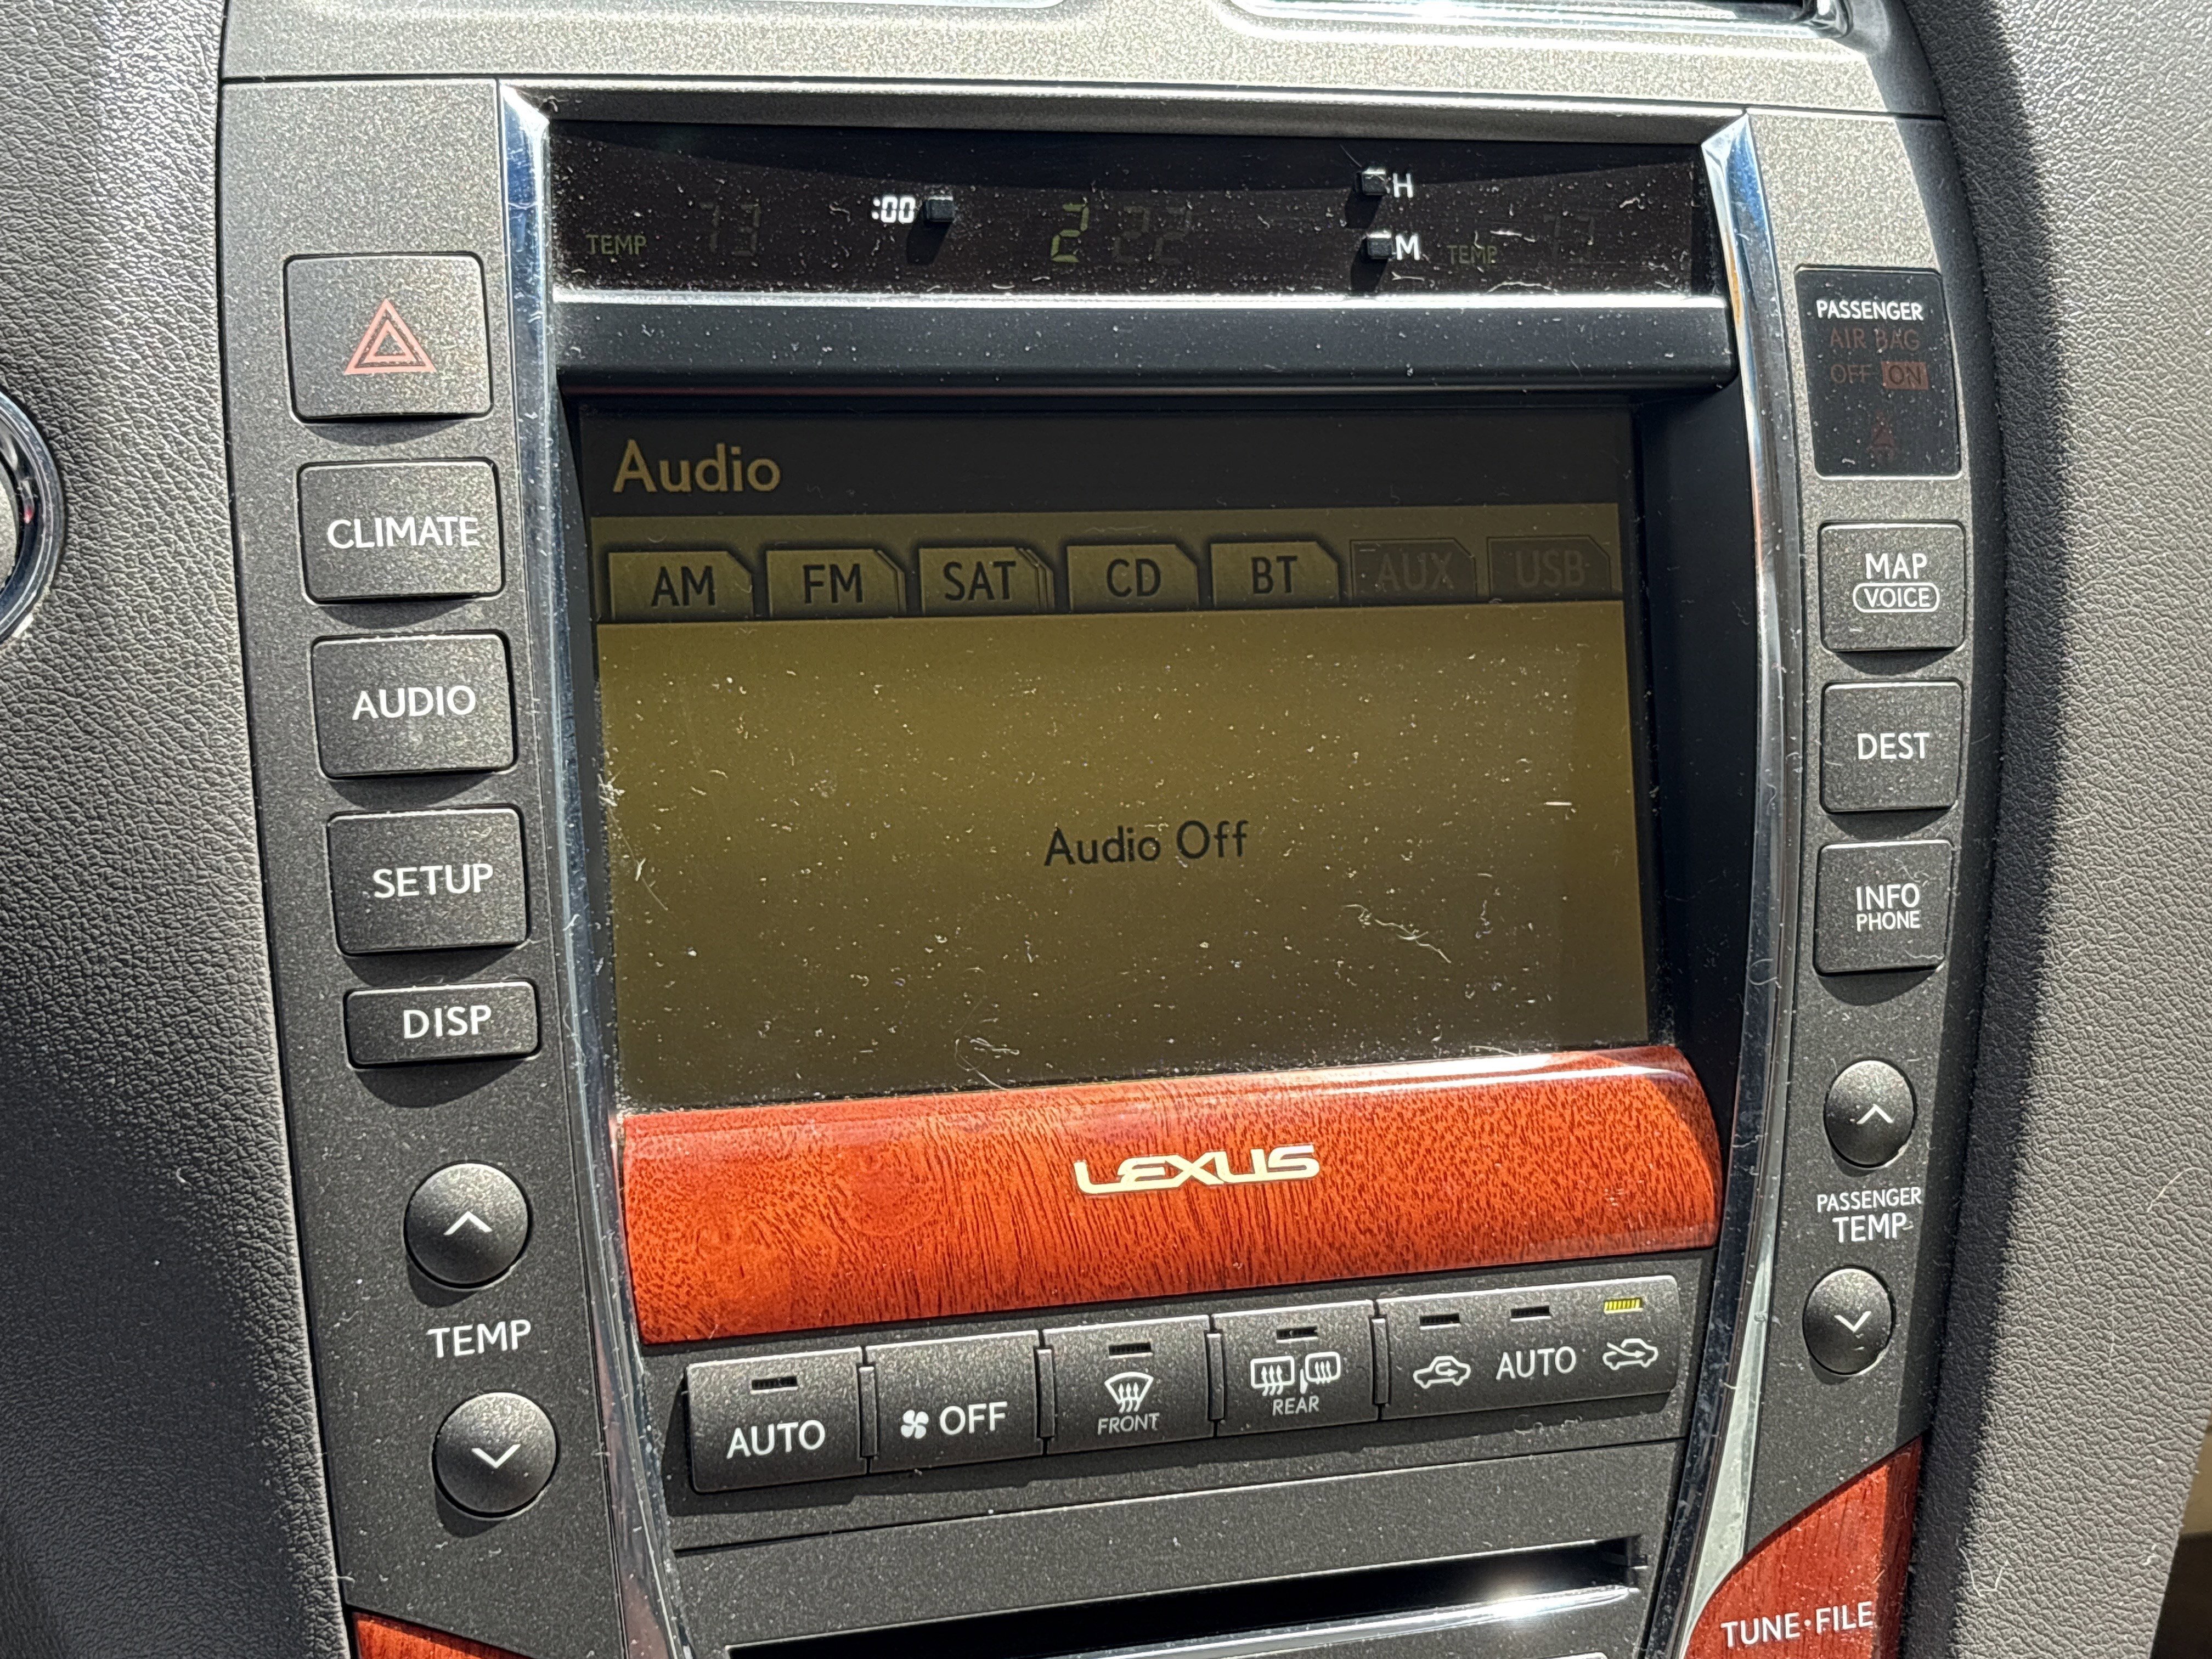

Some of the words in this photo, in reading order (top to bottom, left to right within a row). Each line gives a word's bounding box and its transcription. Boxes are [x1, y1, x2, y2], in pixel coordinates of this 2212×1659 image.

[1392, 173, 1414, 198] H
[873, 195, 916, 223] :00
[586, 234, 647, 256] TEMP
[1395, 234, 1421, 261] M
[1447, 245, 1498, 264] TEMP
[1815, 298, 1924, 321] PASSENGER
[1830, 327, 1866, 349] AIR
[1874, 328, 1920, 351] BAG
[1830, 363, 1872, 384] OFF
[1887, 364, 1922, 386] ON
[613, 439, 782, 494] Audio
[328, 516, 480, 549] CLIMATE
[943, 561, 1016, 602] SAT
[1106, 557, 1161, 597] CD
[1251, 555, 1298, 595] BT
[1377, 552, 1456, 591] AUX
[1515, 549, 1585, 589] USB
[1865, 553, 1928, 579] MAP
[651, 566, 716, 607] AM
[803, 563, 864, 605] FM
[1865, 587, 1930, 608] VOICE
[352, 685, 476, 720] AUDIO
[1858, 733, 1930, 760] DEST
[1044, 826, 1160, 867] Audio
[1176, 820, 1249, 861] Off
[373, 863, 493, 899] SETUP
[1856, 884, 1921, 910] INFO
[1856, 910, 1921, 932] PHONE
[403, 1005, 492, 1039] DISP
[1074, 1144, 1321, 1195] LEXUS
[1818, 1187, 1922, 1212] PASSENGER
[1832, 1212, 1908, 1243] TEMP
[427, 1318, 531, 1358] TEMP
[1496, 1346, 1577, 1382] AUTO
[940, 1401, 1008, 1436] OFF
[1272, 1396, 1319, 1417] REAR
[726, 1419, 825, 1459] AUTO
[1098, 1412, 1160, 1436] FRONT
